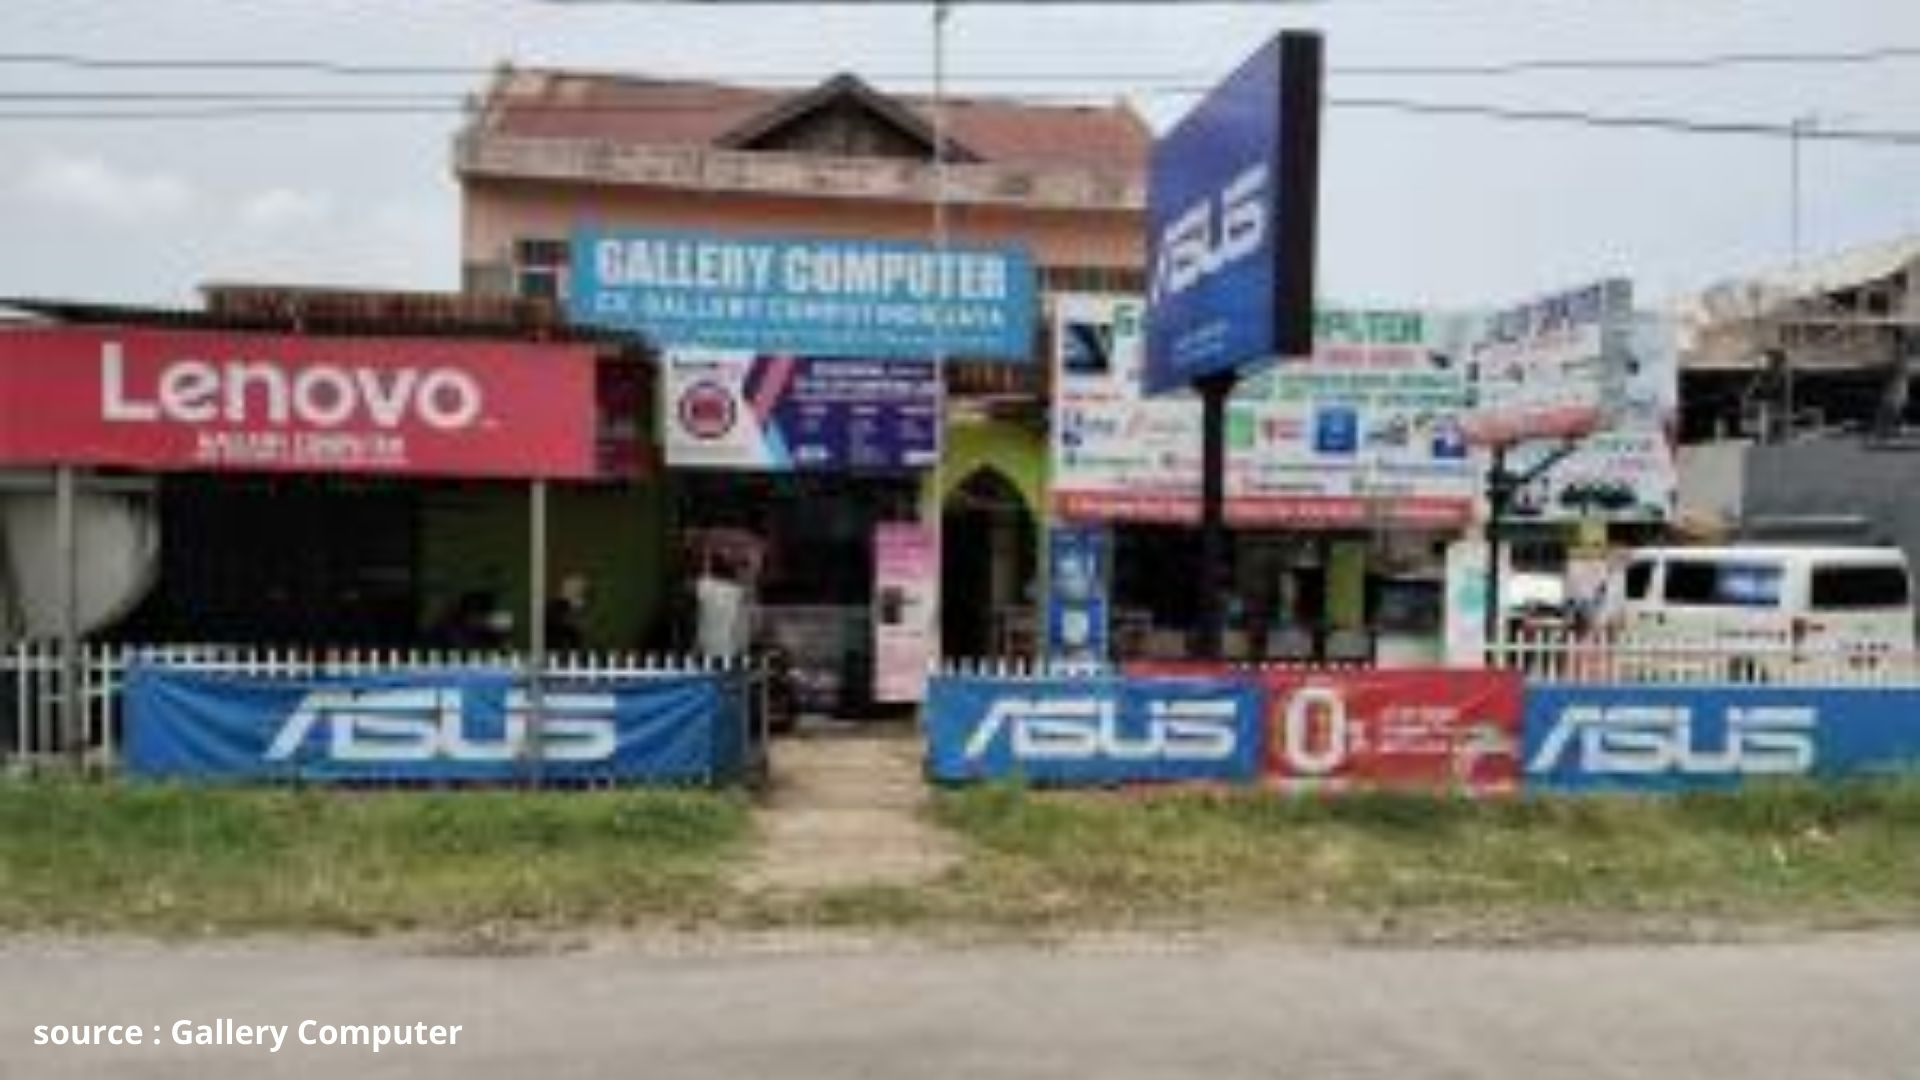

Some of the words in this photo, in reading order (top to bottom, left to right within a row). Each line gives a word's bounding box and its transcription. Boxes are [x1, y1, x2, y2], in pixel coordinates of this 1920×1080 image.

[597, 238, 775, 293] GALLERY
[785, 244, 1007, 300] COMPUTER
[1151, 163, 1270, 305] ASUS
[101, 342, 484, 429] Lenovo
[260, 687, 617, 762] ASUS
[962, 698, 1237, 761] ASUS
[1526, 706, 1819, 775] ASUS
